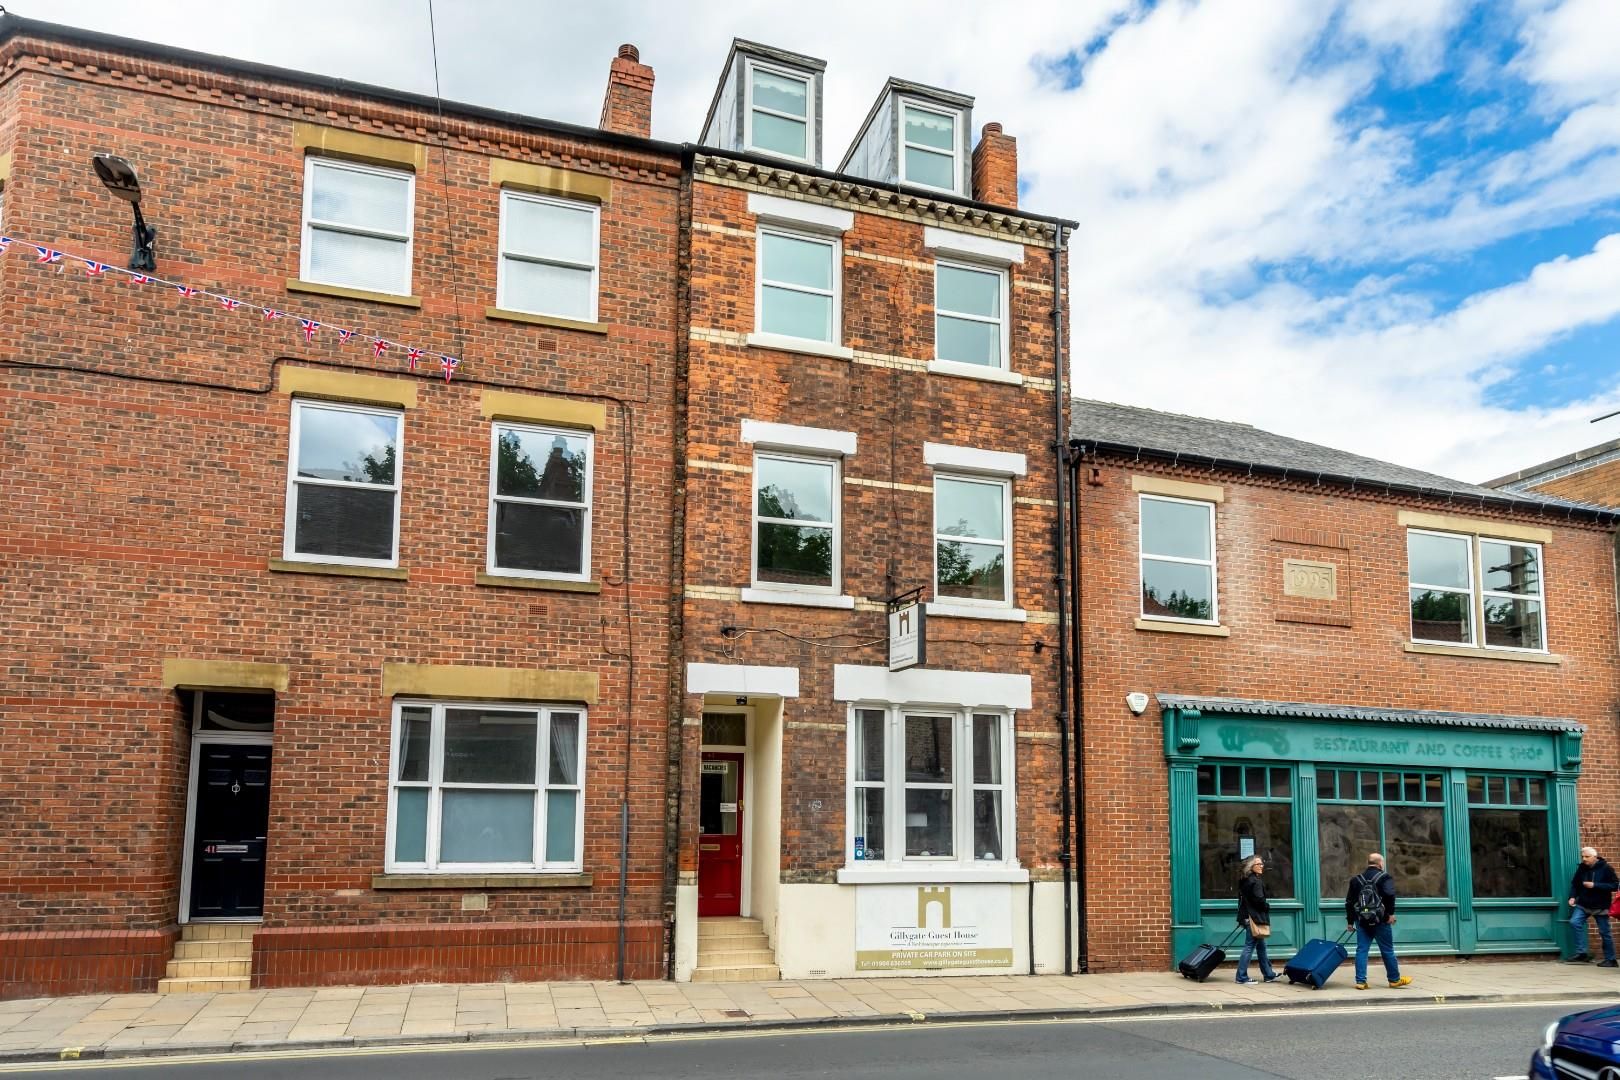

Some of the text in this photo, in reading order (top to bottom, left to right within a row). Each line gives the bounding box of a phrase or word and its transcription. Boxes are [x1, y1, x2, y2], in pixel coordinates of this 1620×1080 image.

[1313, 737, 1544, 761] RESTAURANT AND COFFEE SHOP
[204, 845, 215, 854] 41
[890, 930, 978, 941] Gillygate Guest House
[935, 950, 951, 958] PARK
[952, 950, 963, 958] ON
[964, 950, 977, 958] SITE
